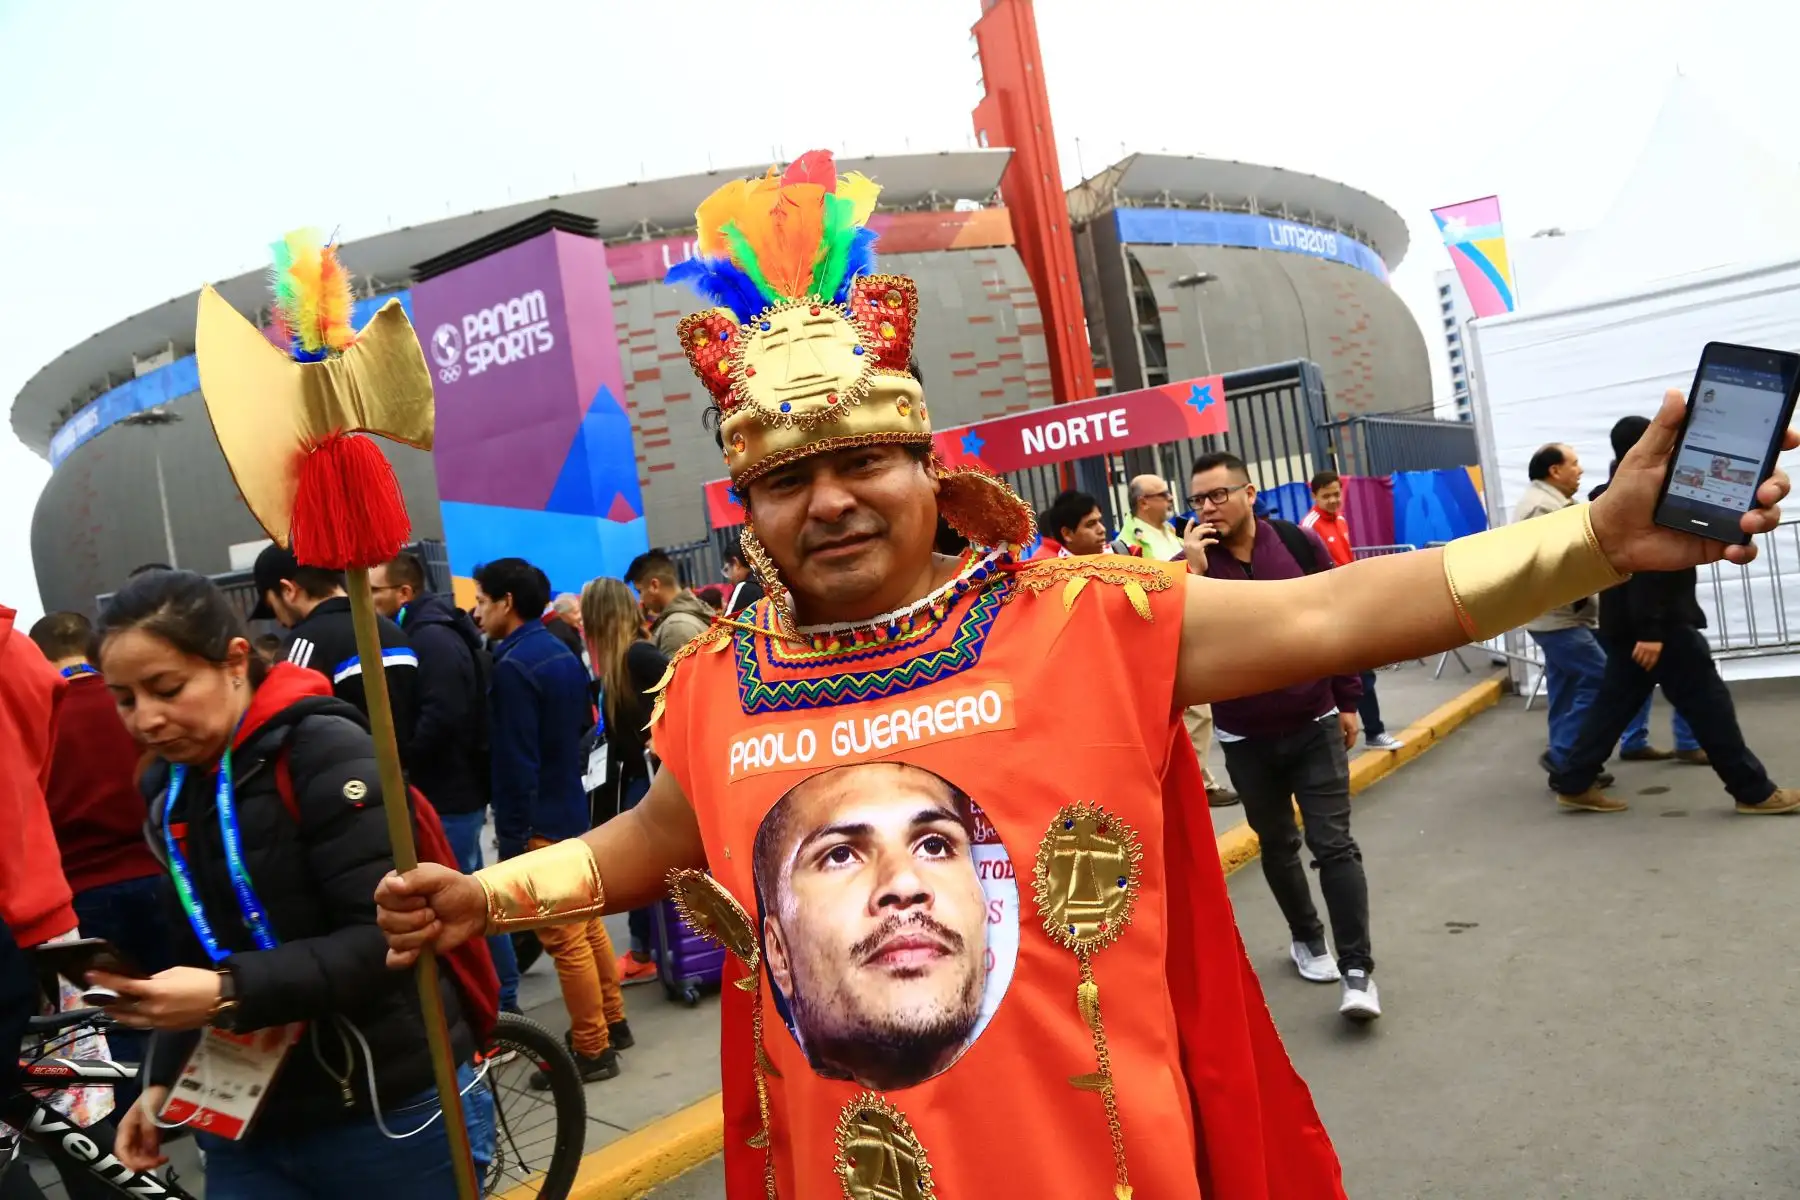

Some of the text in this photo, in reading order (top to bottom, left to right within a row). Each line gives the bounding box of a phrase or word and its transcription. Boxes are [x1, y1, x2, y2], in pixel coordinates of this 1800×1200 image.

[462, 289, 547, 345] PANAM
[464, 320, 554, 376] SPORTS
[1021, 408, 1129, 455] NORTE
[729, 690, 1002, 776] PAOLO GUERRERO
